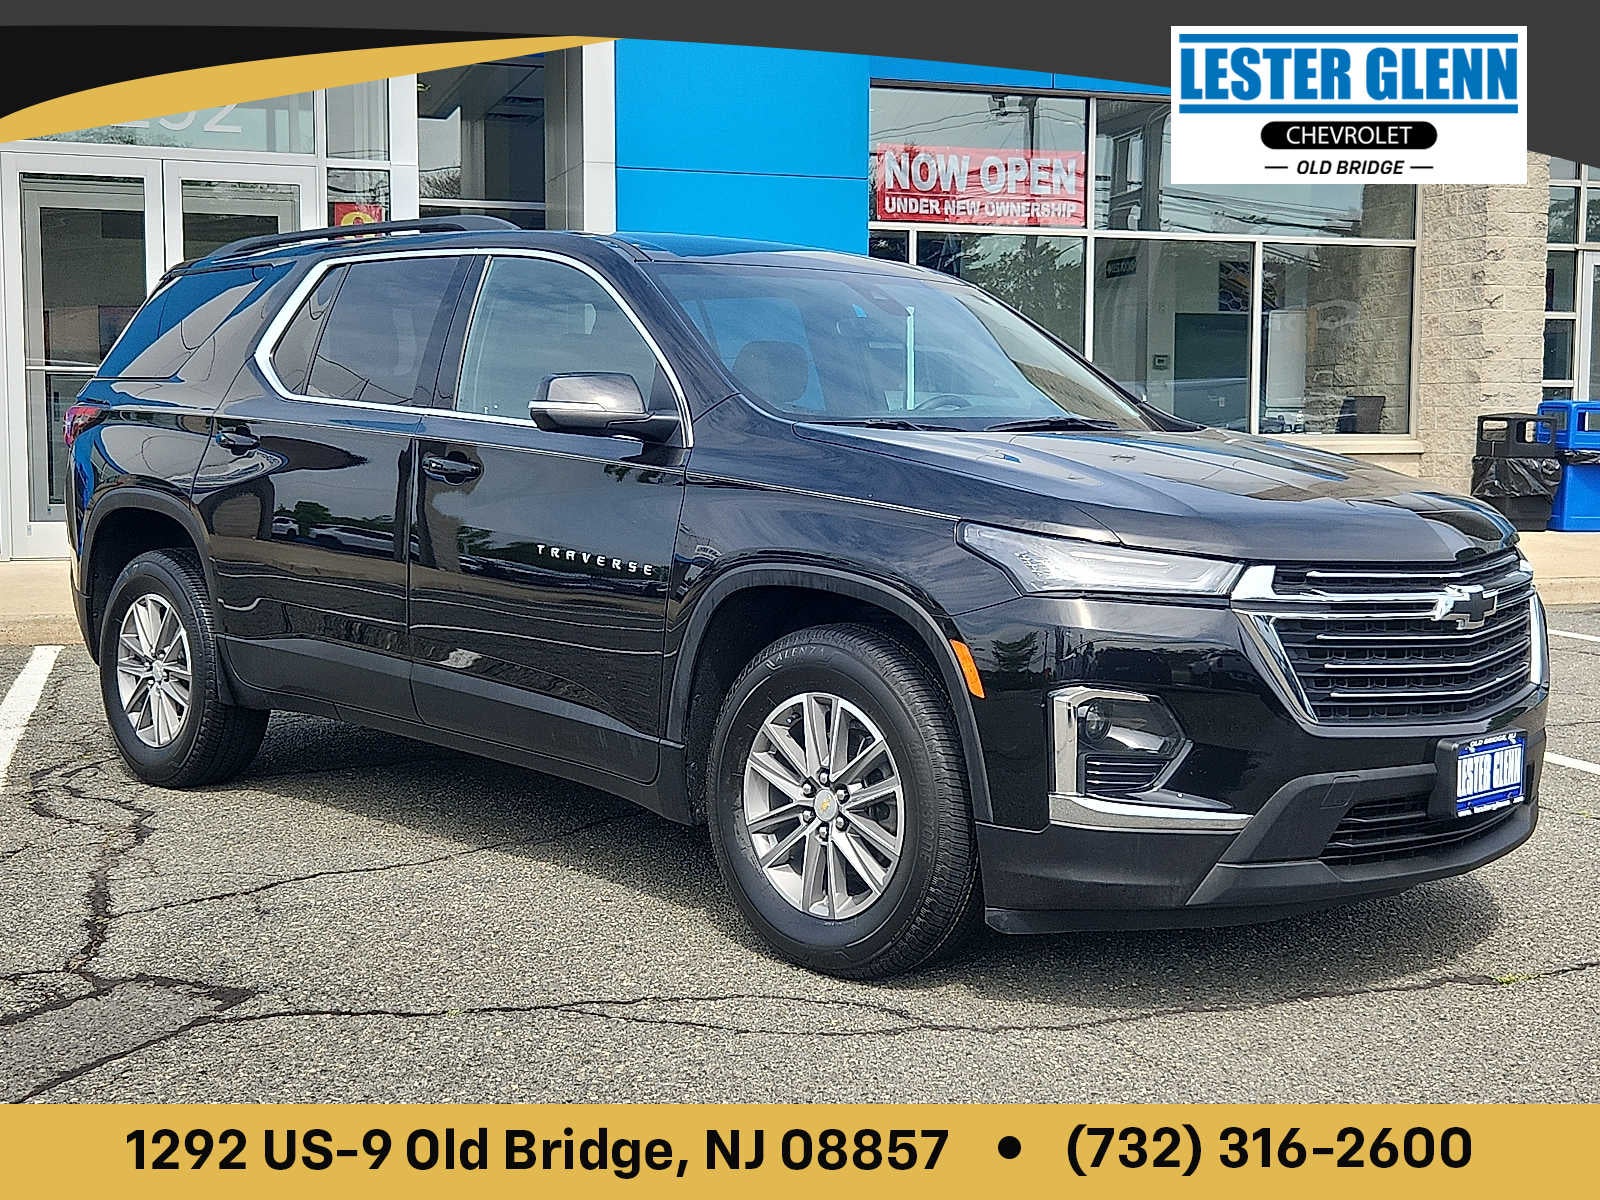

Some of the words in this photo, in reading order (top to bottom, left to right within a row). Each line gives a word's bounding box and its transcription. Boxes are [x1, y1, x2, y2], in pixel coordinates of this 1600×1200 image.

[884, 151, 970, 192] NOW
[980, 156, 1077, 195] OPEN
[884, 197, 941, 215] UNDER
[943, 199, 980, 216] NEW
[984, 201, 1077, 218] OWNERSHIP
[536, 544, 654, 576] TRAVERSE
[1457, 753, 1492, 798] LESTER
[1493, 746, 1521, 789] GLENN
